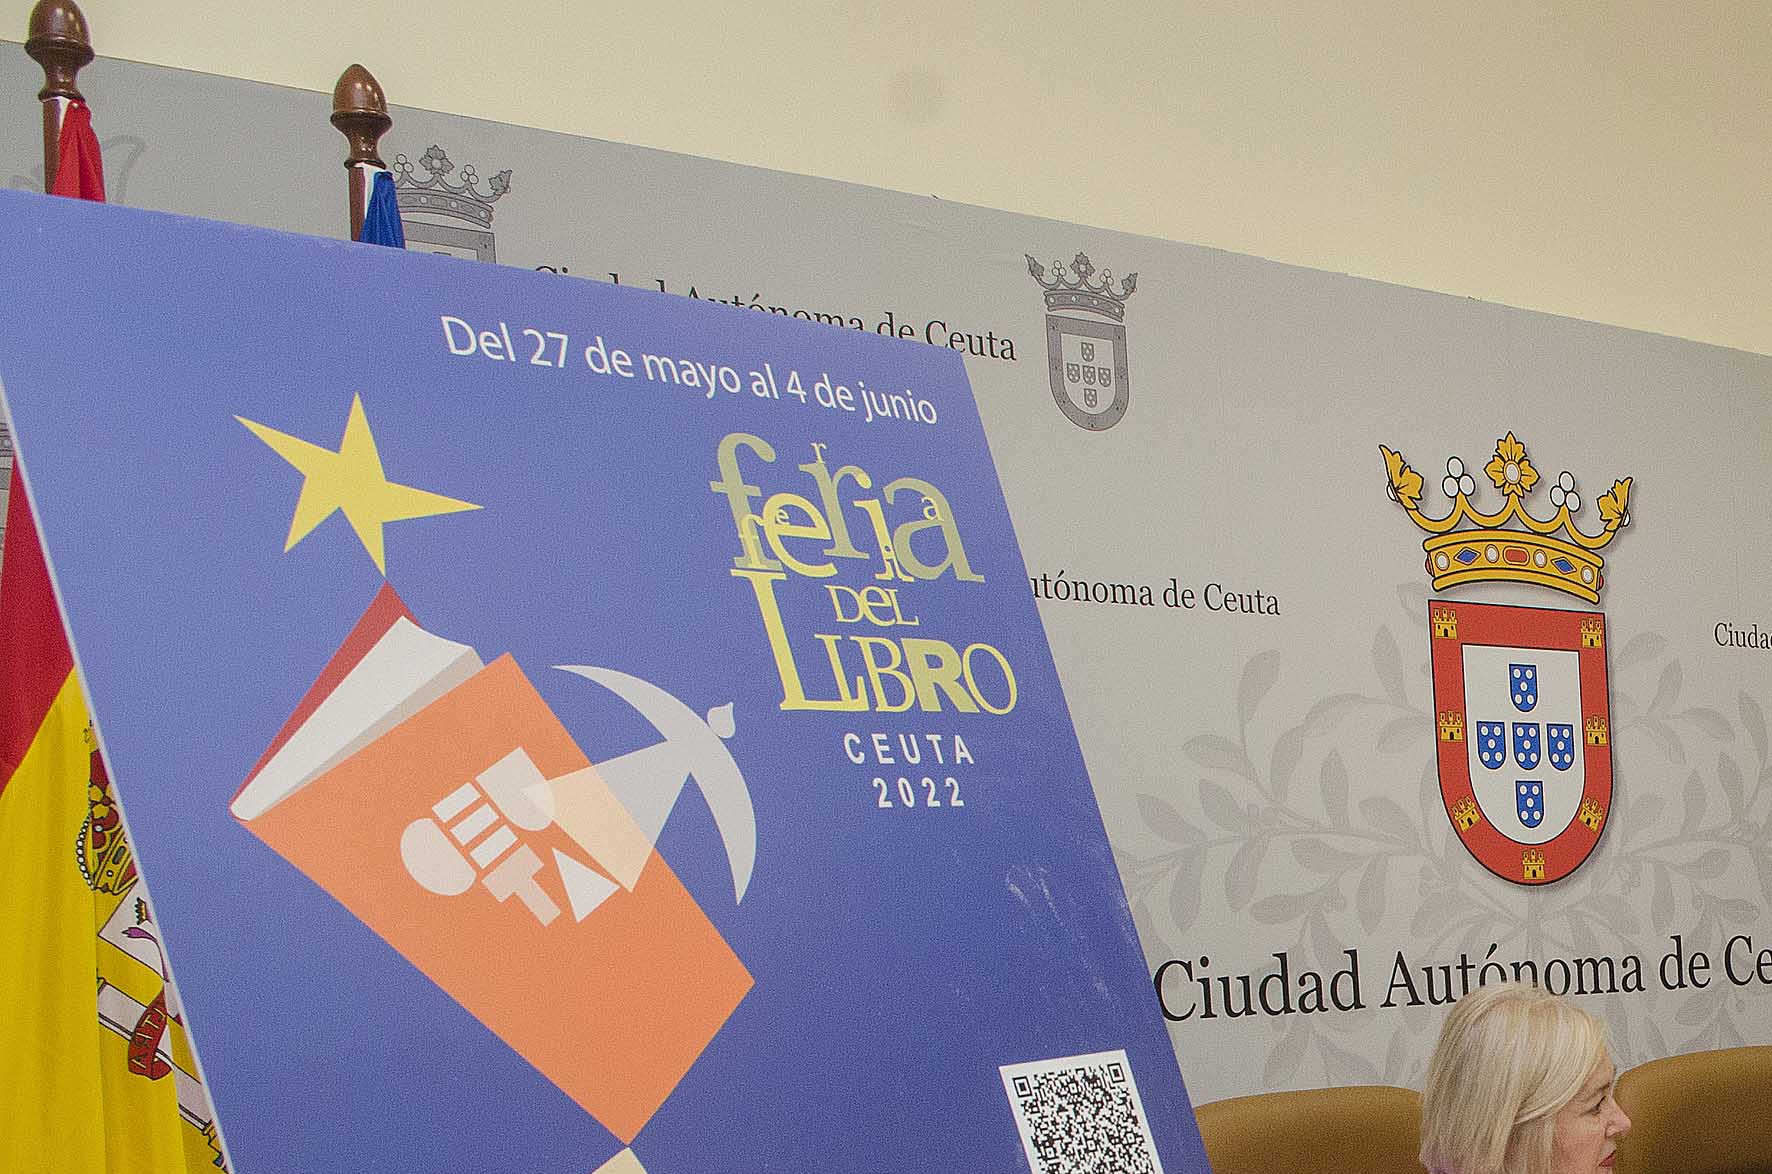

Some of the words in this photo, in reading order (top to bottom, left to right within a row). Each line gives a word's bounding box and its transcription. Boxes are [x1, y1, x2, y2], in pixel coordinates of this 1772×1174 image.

[925, 320, 1016, 361] Ceuta
[441, 315, 517, 362] Del
[523, 328, 568, 369] 27
[585, 335, 635, 378] de
[641, 353, 741, 399] mayo
[750, 363, 779, 400] al
[787, 370, 806, 403] 4
[814, 373, 856, 412] de
[859, 381, 938, 424] junio
[1030, 569, 1156, 606] tónoma
[1162, 578, 1196, 609] de
[1203, 583, 1281, 616] Ceuta
[843, 732, 975, 765] CEUTA
[872, 777, 965, 809] 2022
[1153, 948, 1367, 1022] Ciudad
[1380, 943, 1647, 1008] Autónoma
[1659, 935, 1712, 989] de
